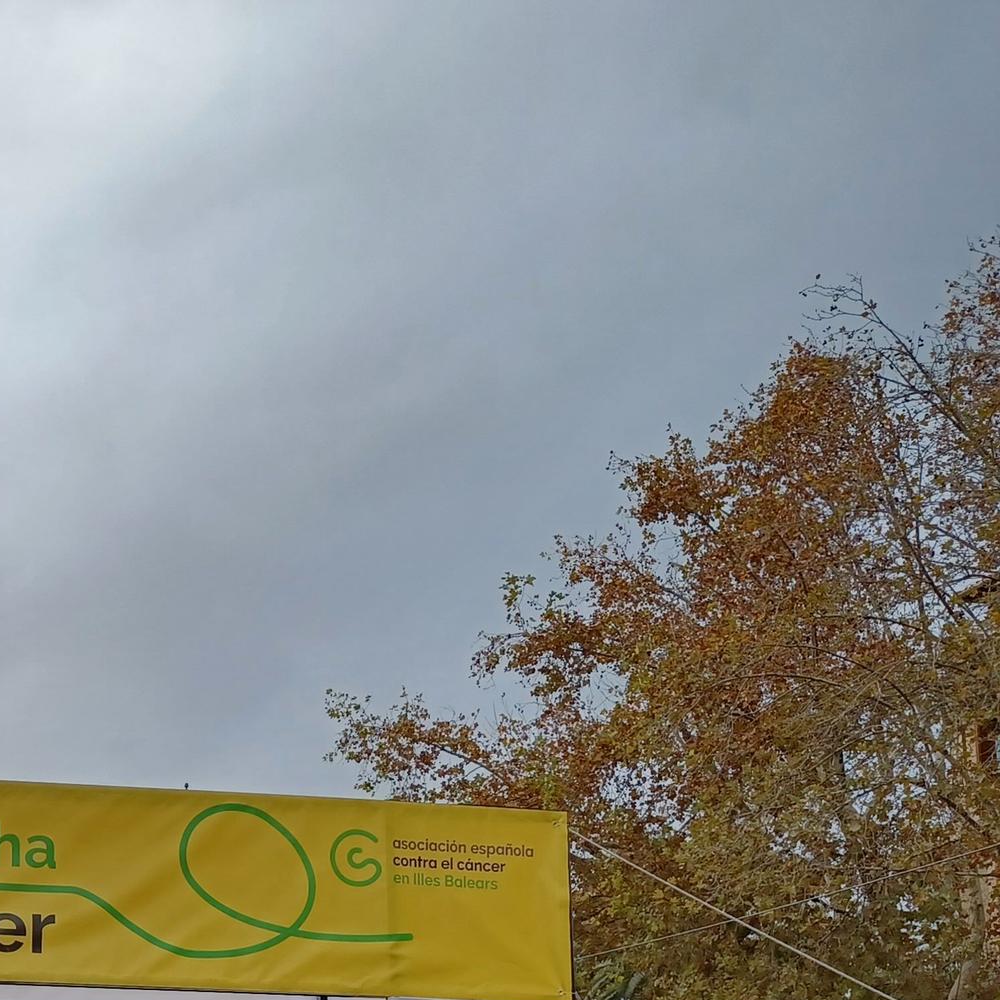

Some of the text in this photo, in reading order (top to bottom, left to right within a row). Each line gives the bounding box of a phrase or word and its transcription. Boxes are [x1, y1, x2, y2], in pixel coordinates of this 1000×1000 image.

[392, 837, 534, 858] asociación española
[393, 854, 506, 873] contra el cáncer
[393, 872, 498, 890] en Illes Balears
